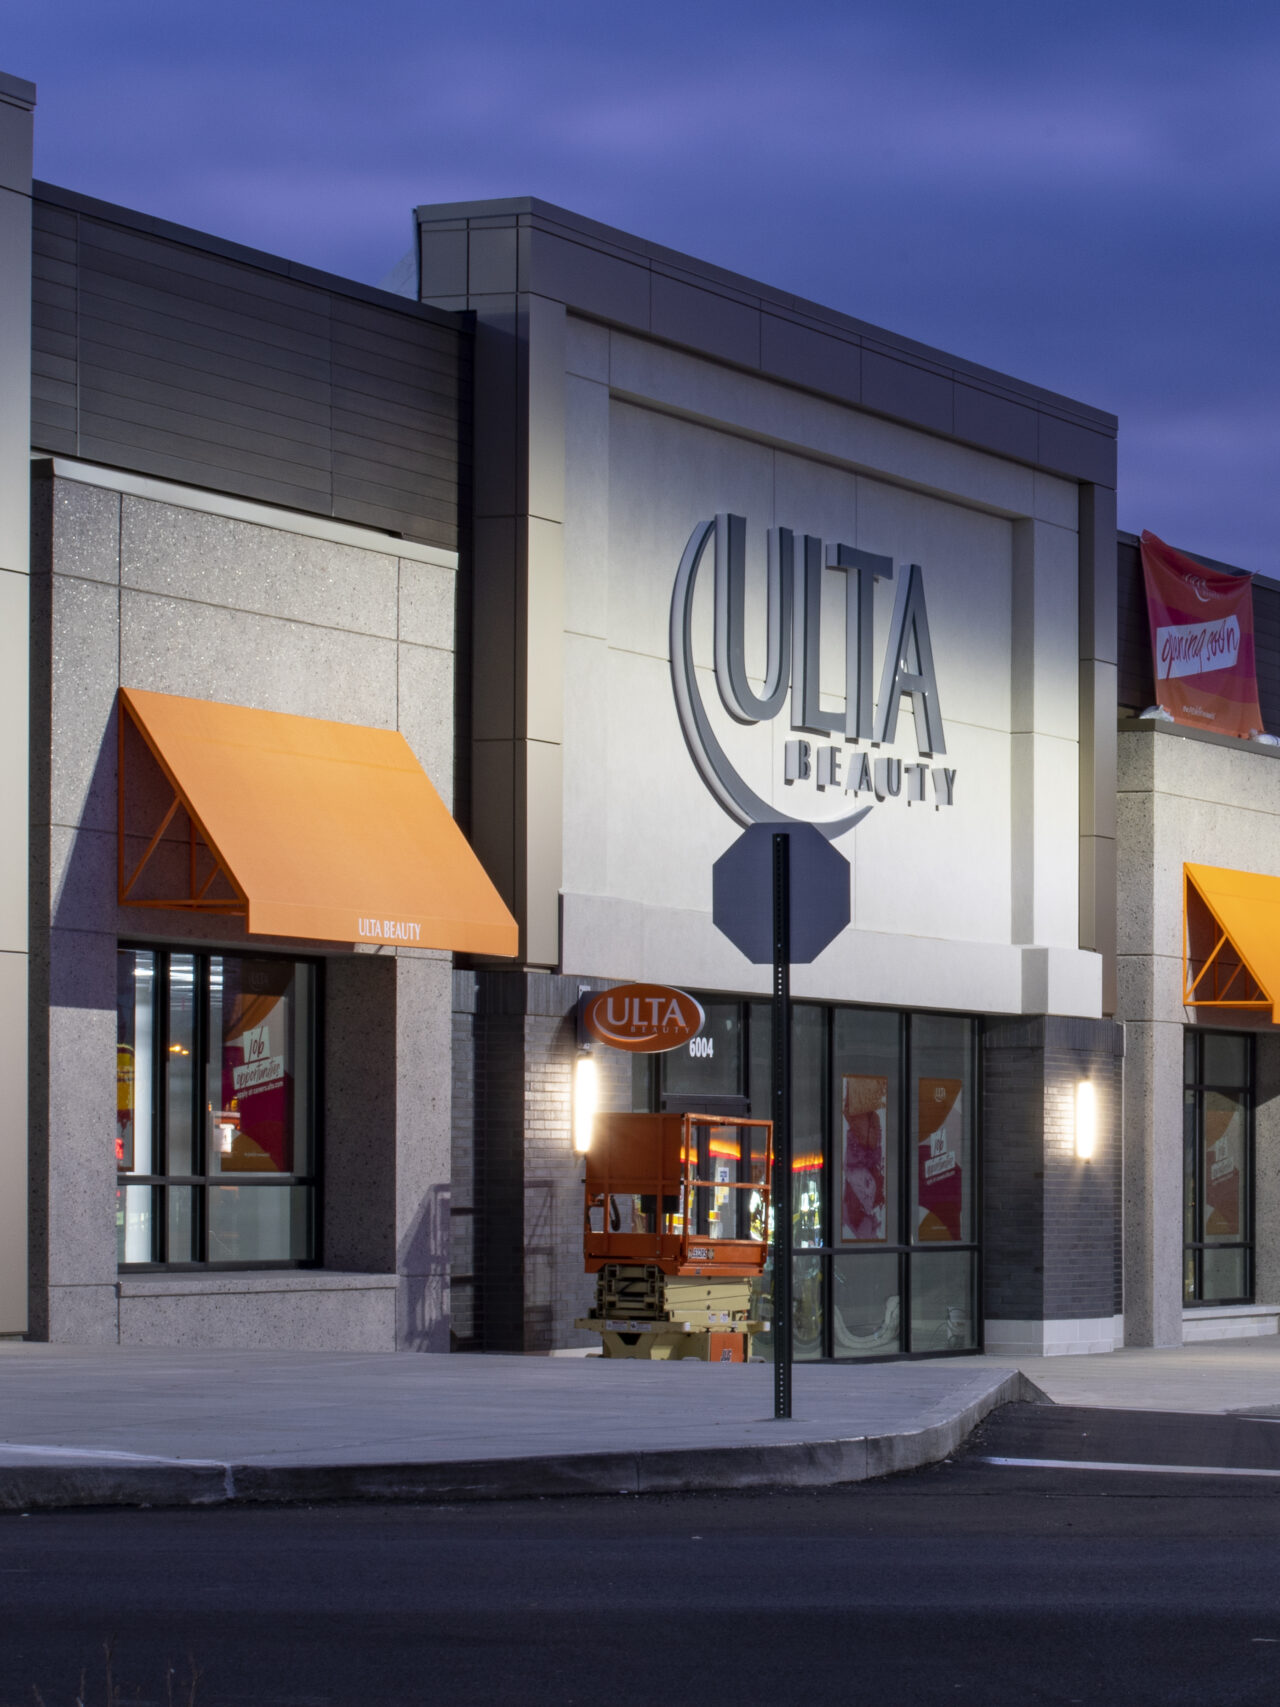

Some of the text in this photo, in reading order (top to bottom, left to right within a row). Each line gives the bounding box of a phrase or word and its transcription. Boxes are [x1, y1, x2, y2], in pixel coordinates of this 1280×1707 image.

[714, 512, 947, 756] ULTA
[1161, 620, 1239, 680] opening soon
[784, 739, 957, 807] BEAUTY
[358, 918, 421, 940] ULTA BEAUTY
[607, 997, 687, 1027] ULTA
[630, 1026, 691, 1034] BEAUTY
[689, 1037, 714, 1058] 6004
